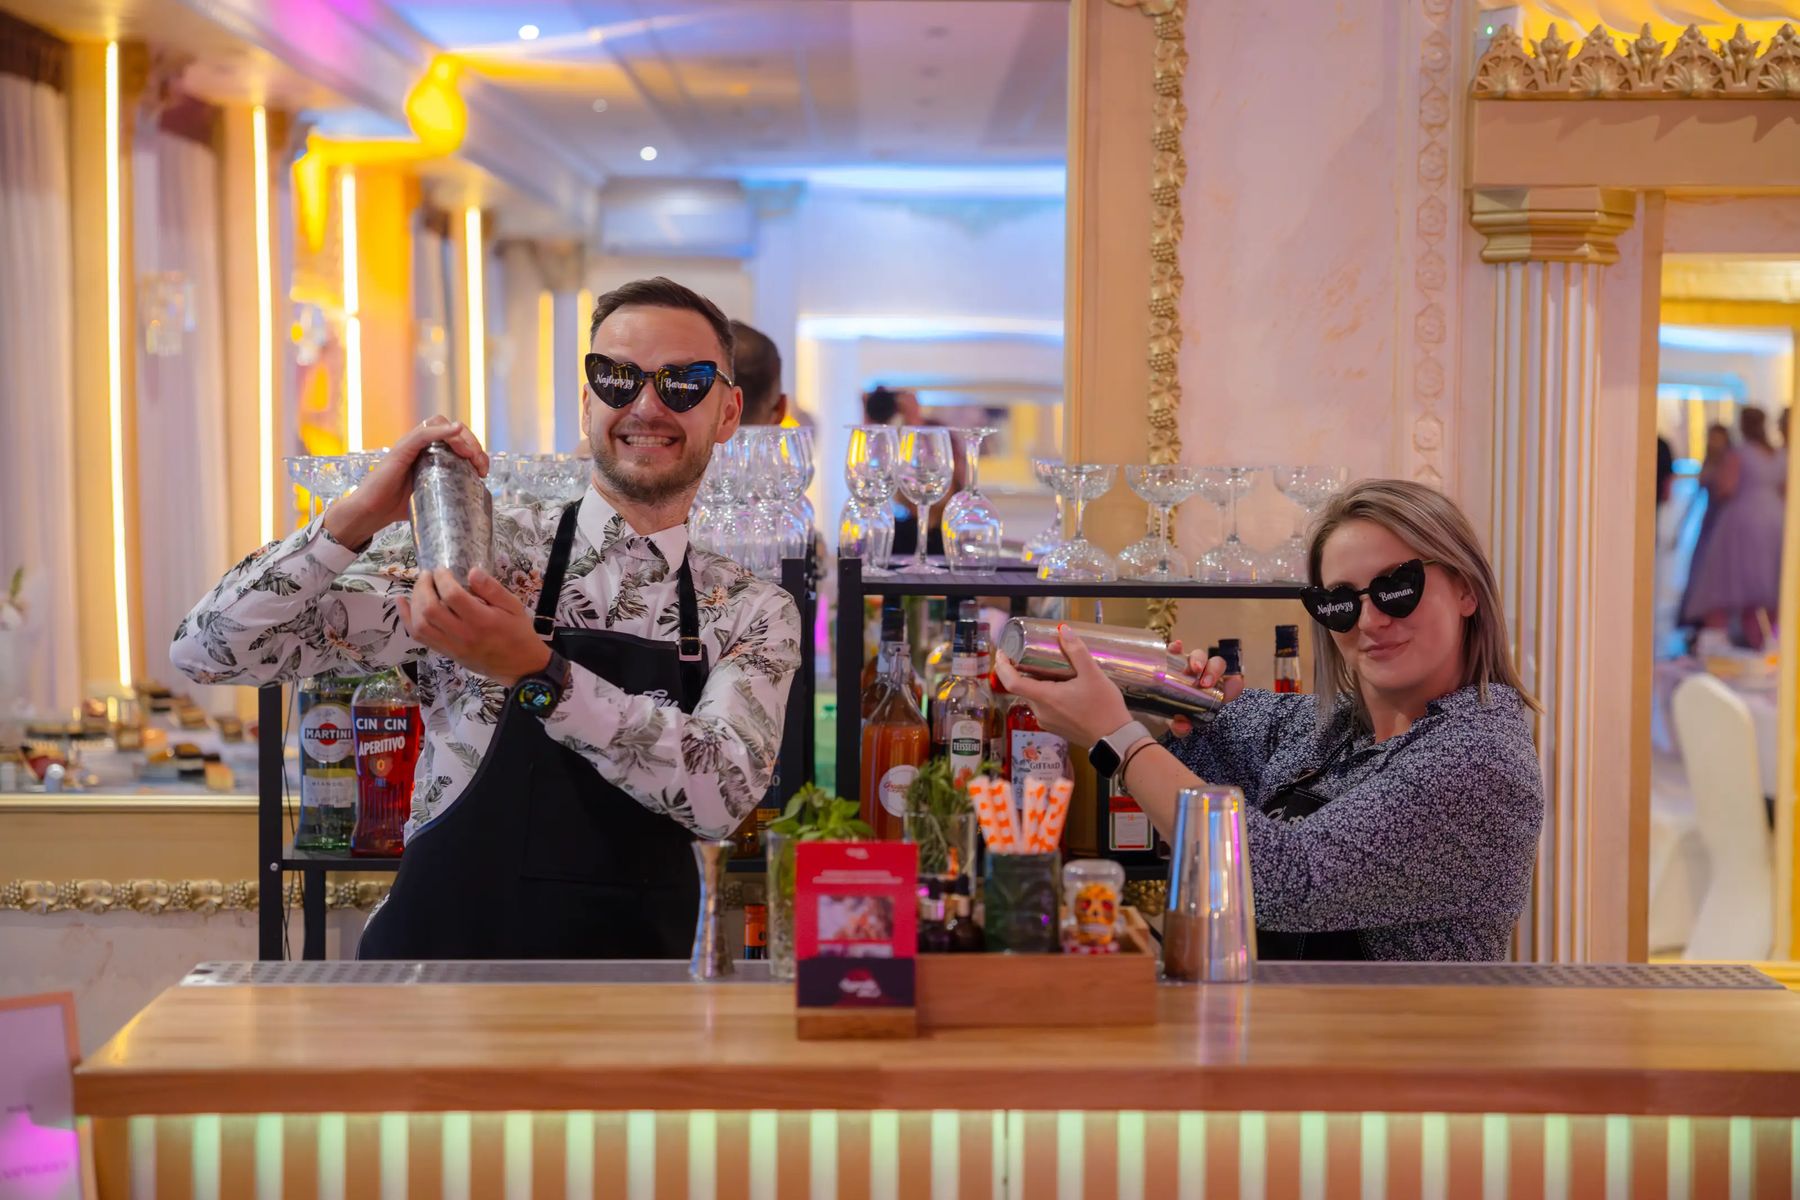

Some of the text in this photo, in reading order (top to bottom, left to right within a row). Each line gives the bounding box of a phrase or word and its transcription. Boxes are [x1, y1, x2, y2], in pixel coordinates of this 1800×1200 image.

[664, 377, 699, 391] Barman
[1317, 588, 1414, 616] Najlepszy Barman
[356, 718, 407, 730] CIN CIN
[306, 729, 352, 739] MARTINI
[358, 736, 405, 756] APERITIVO
